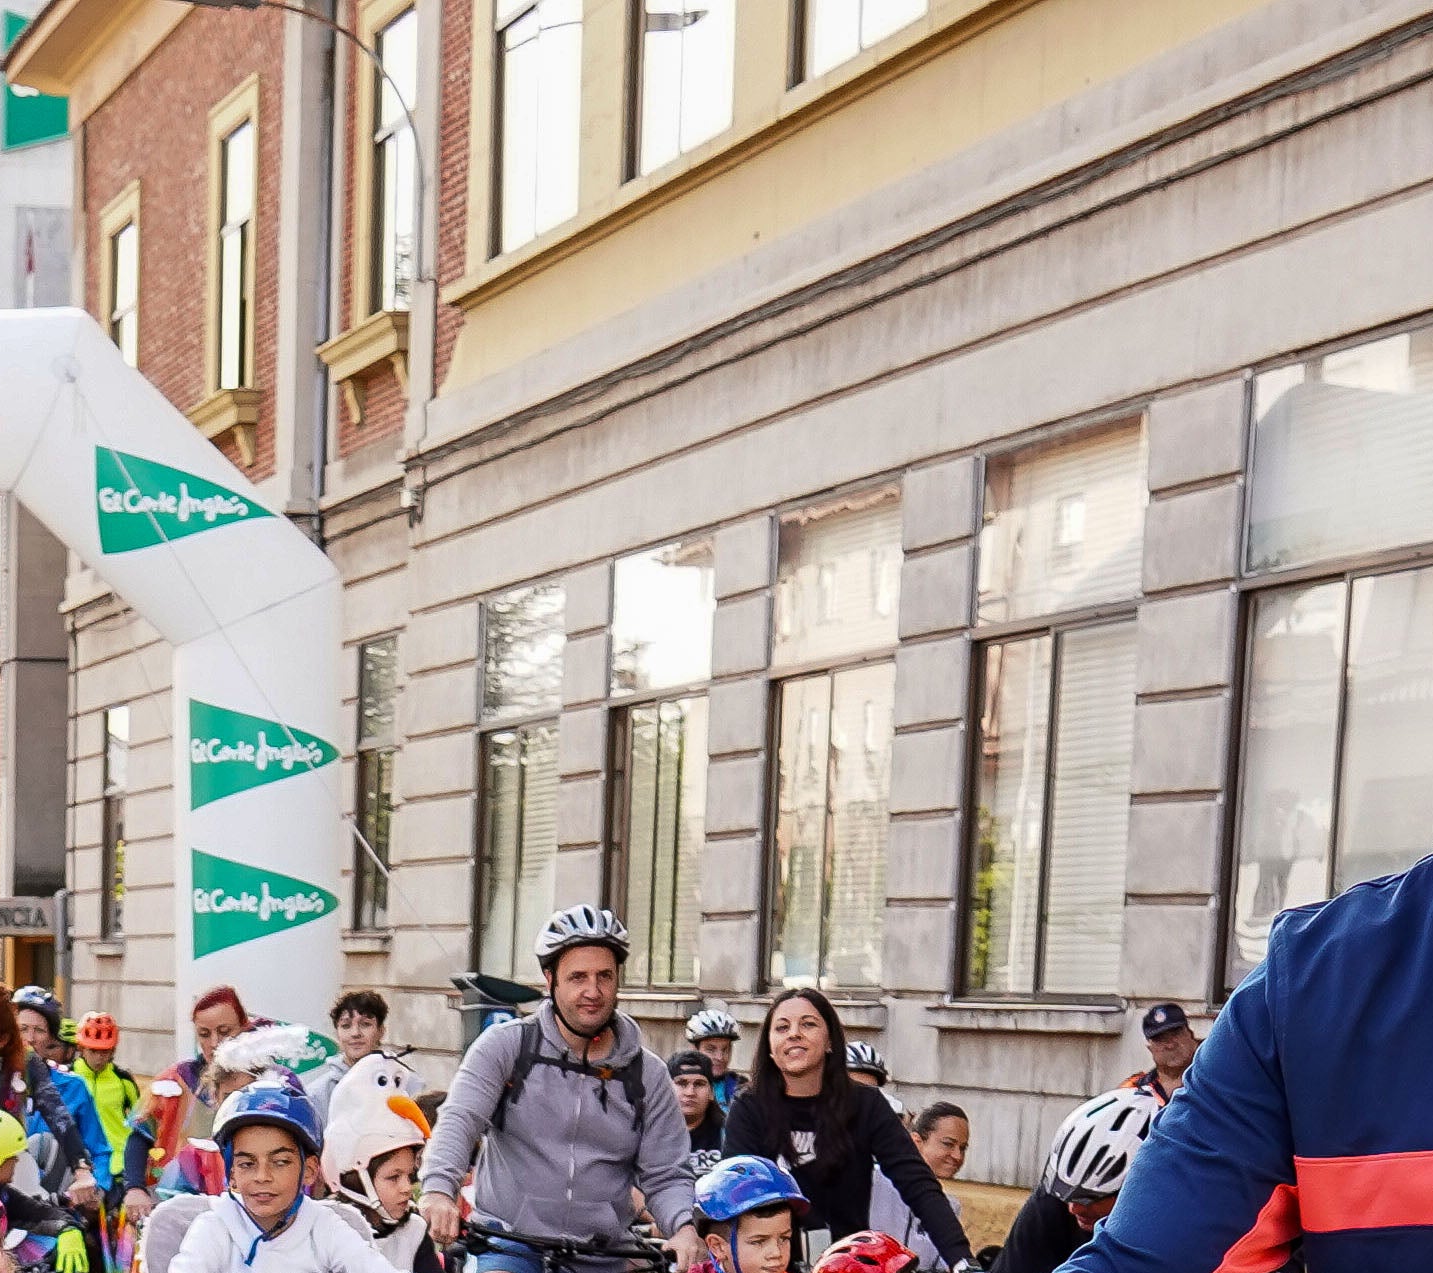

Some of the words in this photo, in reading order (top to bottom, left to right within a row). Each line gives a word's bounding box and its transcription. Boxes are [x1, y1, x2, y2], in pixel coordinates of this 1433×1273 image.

[123, 488, 177, 514] Corte
[177, 482, 249, 522] Inglés
[207, 738, 255, 763] Corte
[255, 731, 324, 771] Inglés
[210, 888, 258, 913] Corte
[258, 882, 325, 921] Inglés
